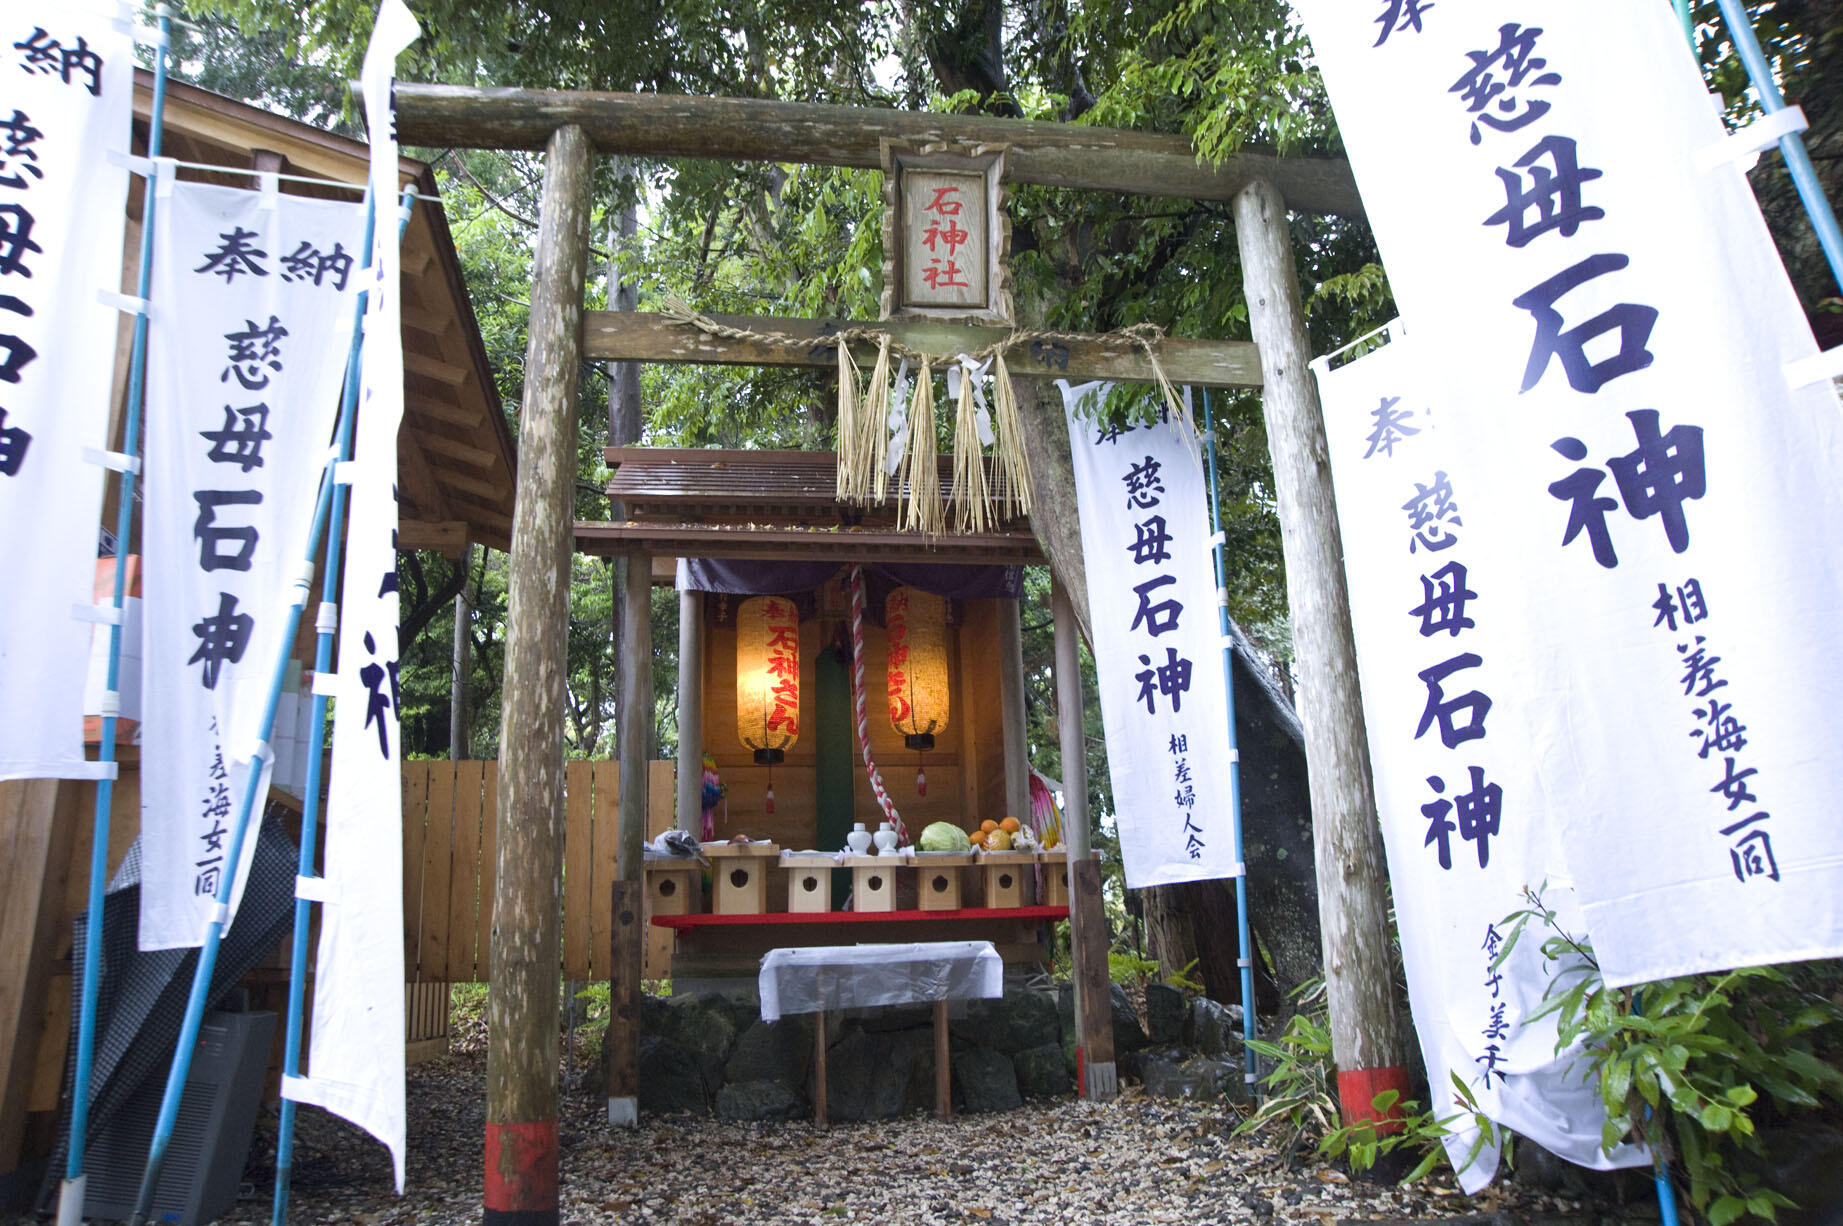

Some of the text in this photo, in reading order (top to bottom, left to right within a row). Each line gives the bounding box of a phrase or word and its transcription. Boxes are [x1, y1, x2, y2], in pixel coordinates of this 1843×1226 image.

[194, 226, 355, 292] 奉納
[922, 186, 969, 291] 石神社
[1448, 23, 1706, 568] 慈母石神
[187, 315, 289, 690] 慈母石神
[1121, 455, 1193, 715] 慈母石神
[1168, 733, 1206, 861] 相差婦人会
[1401, 470, 1504, 871] 慈母石神
[1652, 578, 1780, 883] 相差海女一同
